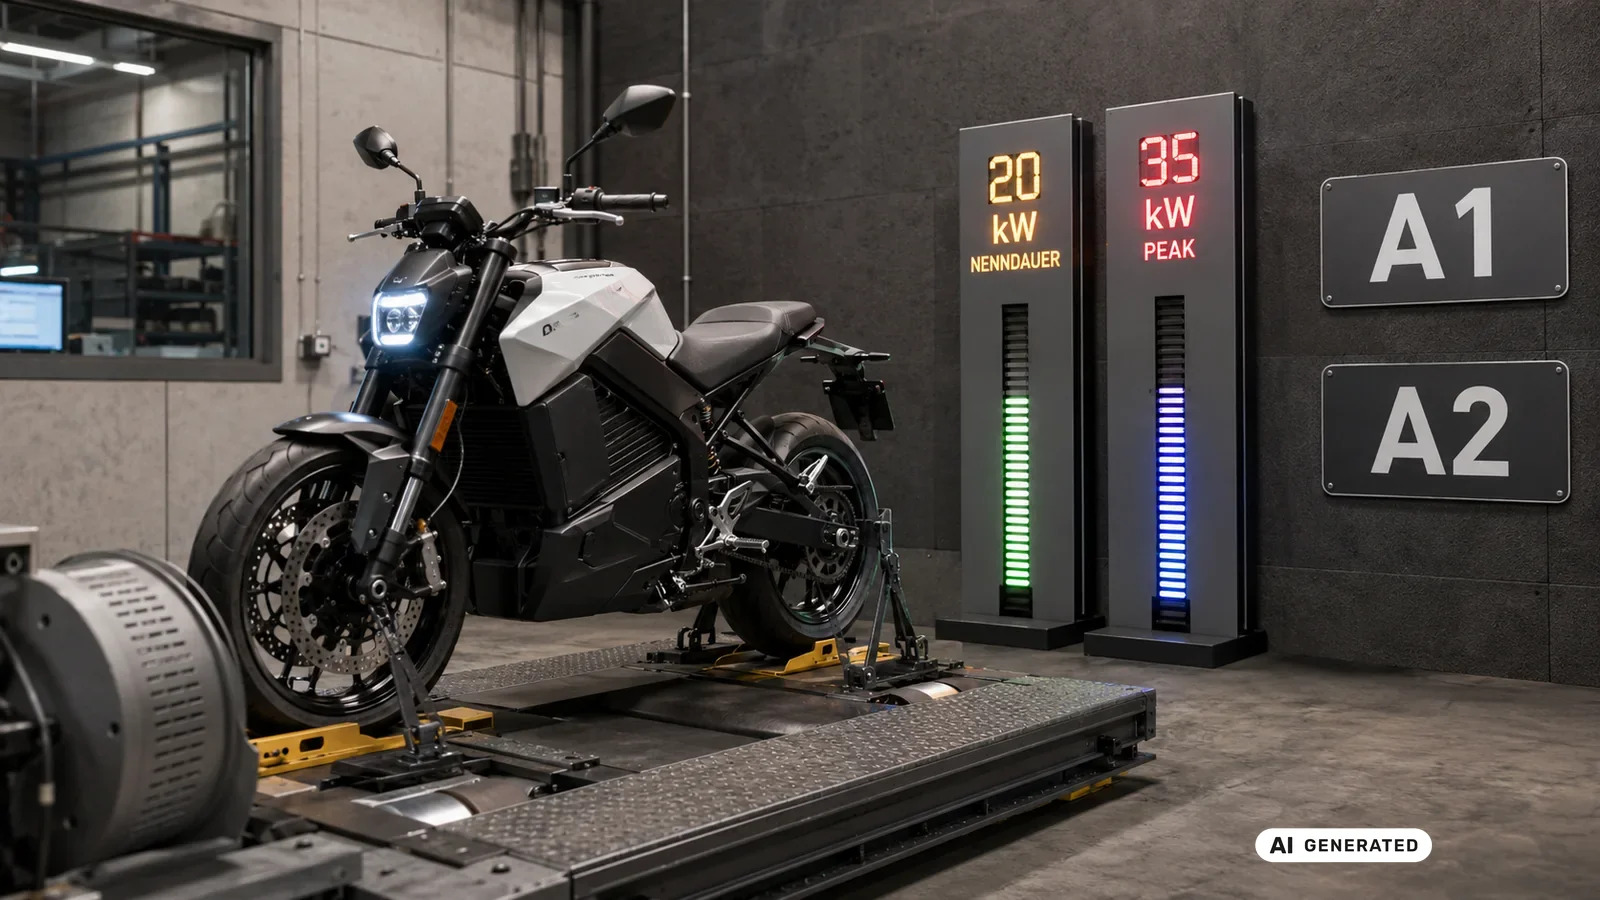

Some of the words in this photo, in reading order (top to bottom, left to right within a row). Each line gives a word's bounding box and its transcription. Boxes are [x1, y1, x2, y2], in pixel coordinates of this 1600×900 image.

[989, 151, 1040, 204] 20
[1140, 132, 1198, 186] 35
[993, 211, 1037, 244] kW
[1145, 195, 1195, 230] kW
[1144, 238, 1195, 261] PEAK
[1370, 187, 1492, 283] A1
[970, 251, 1060, 273] NENNDAUER
[1370, 385, 1509, 477] A2
